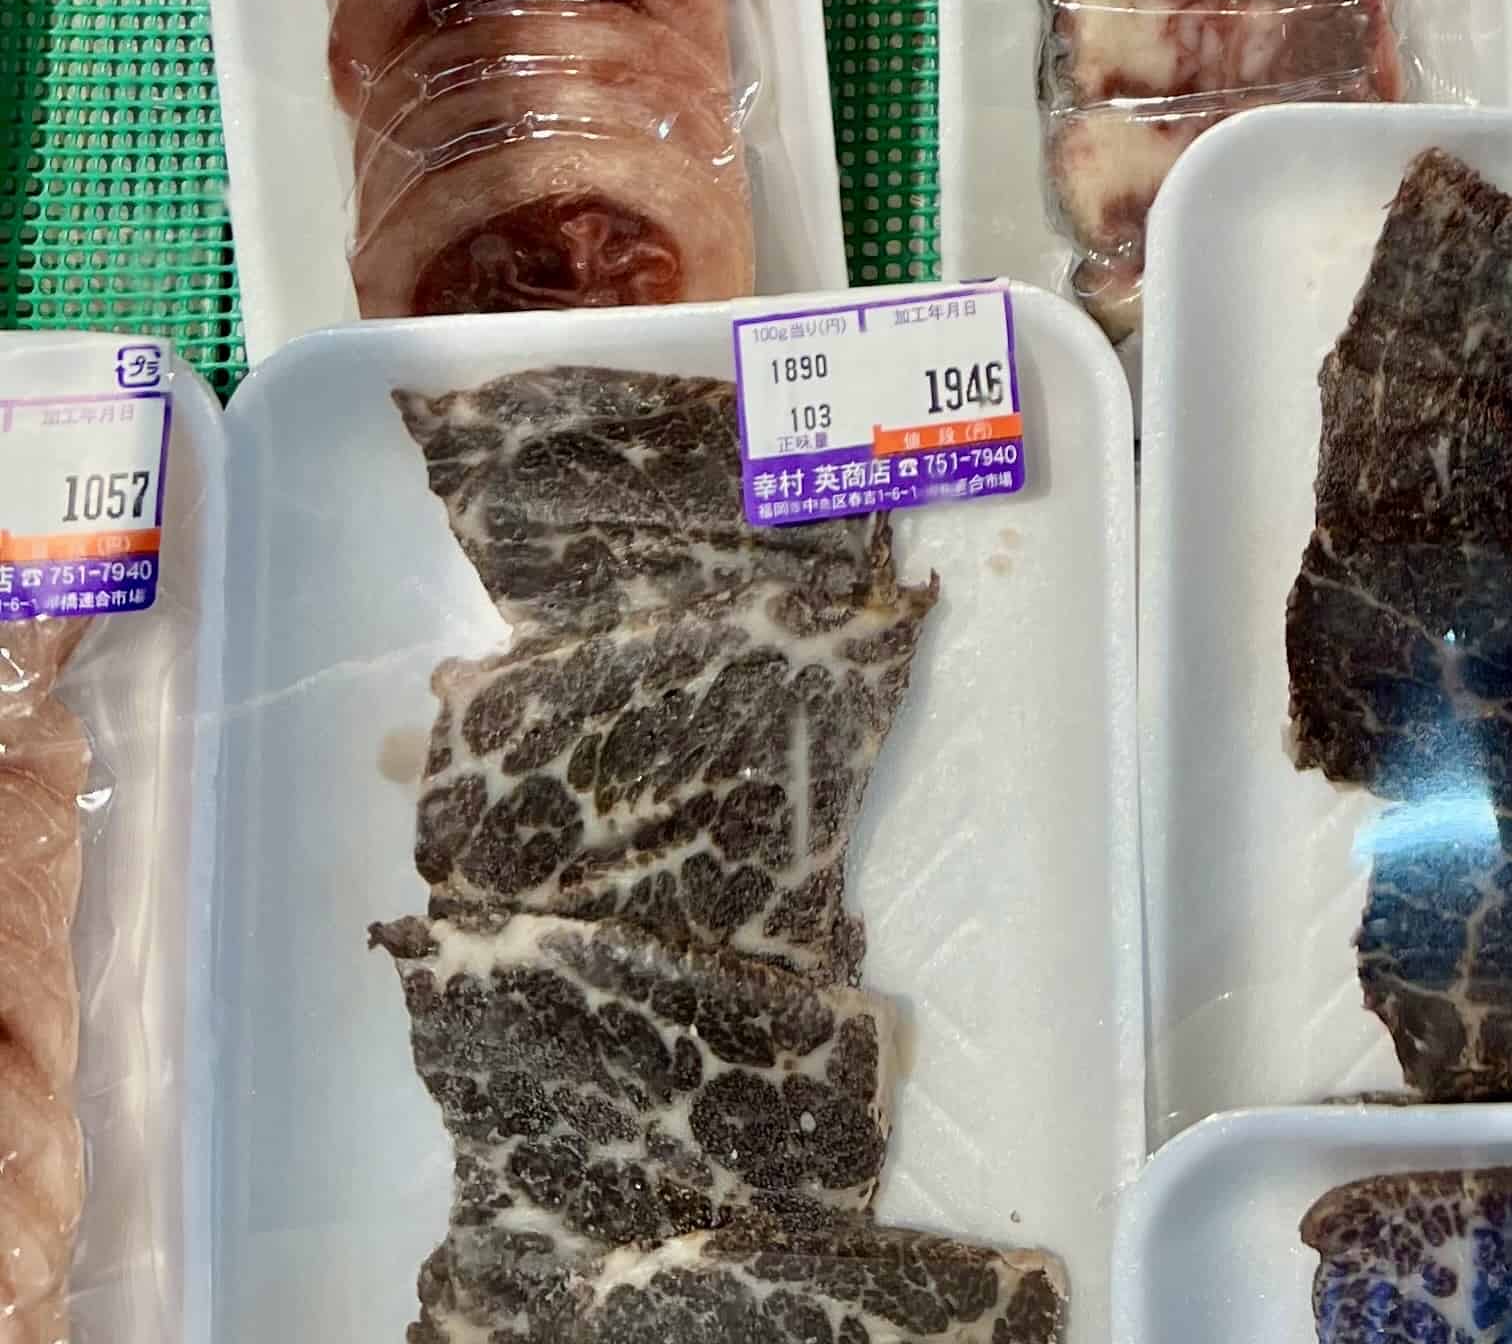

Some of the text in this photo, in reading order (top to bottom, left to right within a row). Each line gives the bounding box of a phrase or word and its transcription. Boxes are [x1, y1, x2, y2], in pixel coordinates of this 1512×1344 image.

[754, 318, 847, 343] 100g当り(円)
[129, 355, 159, 377] プラ
[771, 354, 828, 384] 1890
[925, 362, 1004, 414] 1946
[790, 403, 832, 433] 103
[776, 432, 829, 454] 正味量
[753, 444, 1017, 500] 幸村 英商店 751-7940
[62, 471, 150, 522] 1057
[50, 560, 152, 585] 751-7940
